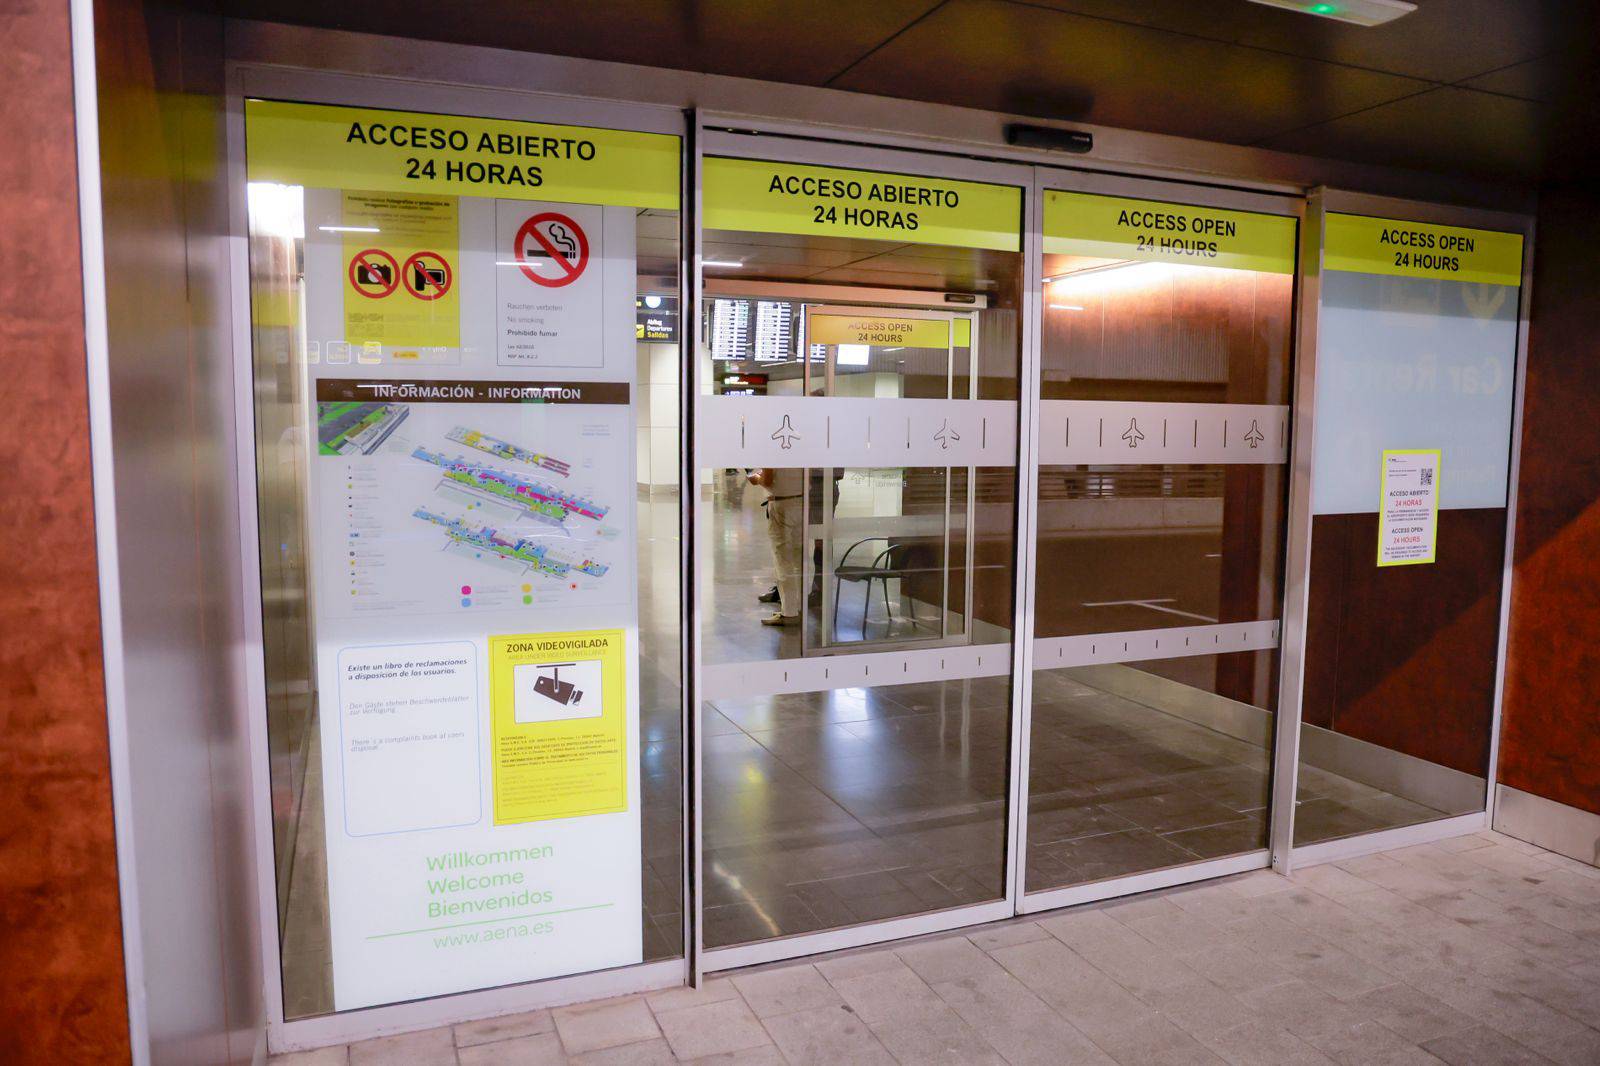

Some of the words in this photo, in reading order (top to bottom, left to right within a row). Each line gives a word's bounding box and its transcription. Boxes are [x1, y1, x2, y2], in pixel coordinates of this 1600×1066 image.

[346, 122, 469, 151] ACCESO
[476, 132, 596, 161] ABIERTO
[406, 158, 436, 180] 24
[446, 161, 543, 187] HORAS
[768, 175, 862, 200] ACCESO
[868, 183, 959, 208] ABIERTO
[813, 205, 837, 224] 24
[844, 208, 919, 230] HORAS
[1117, 210, 1187, 232] ACCESS
[1192, 218, 1236, 237] OPEN
[1136, 235, 1154, 252] 24
[1160, 238, 1218, 258] HOURS
[1380, 229, 1435, 248] ACCESS
[1439, 235, 1475, 252] OPEN
[1395, 252, 1409, 267] 24
[1413, 254, 1459, 271] HOURS
[647, 331, 669, 339] Salidas
[858, 333, 868, 341] 24
[871, 334, 903, 343] HOURS
[888, 323, 913, 332] OPEN
[373, 384, 474, 399] INFORMACIÓN
[488, 387, 581, 400] INFORMATION
[506, 643, 534, 653] ZONA
[536, 639, 609, 651] VIDEOVIGILADA
[347, 664, 371, 672] Existe
[384, 662, 403, 670] libro
[404, 661, 413, 669] de
[415, 659, 467, 668] reclamaciones
[411, 669, 421, 677] los
[426, 844, 554, 872] Willkommen
[427, 871, 525, 895] Welcome
[427, 889, 553, 918] Bienvenidos
[433, 919, 555, 949] www.aena.es
